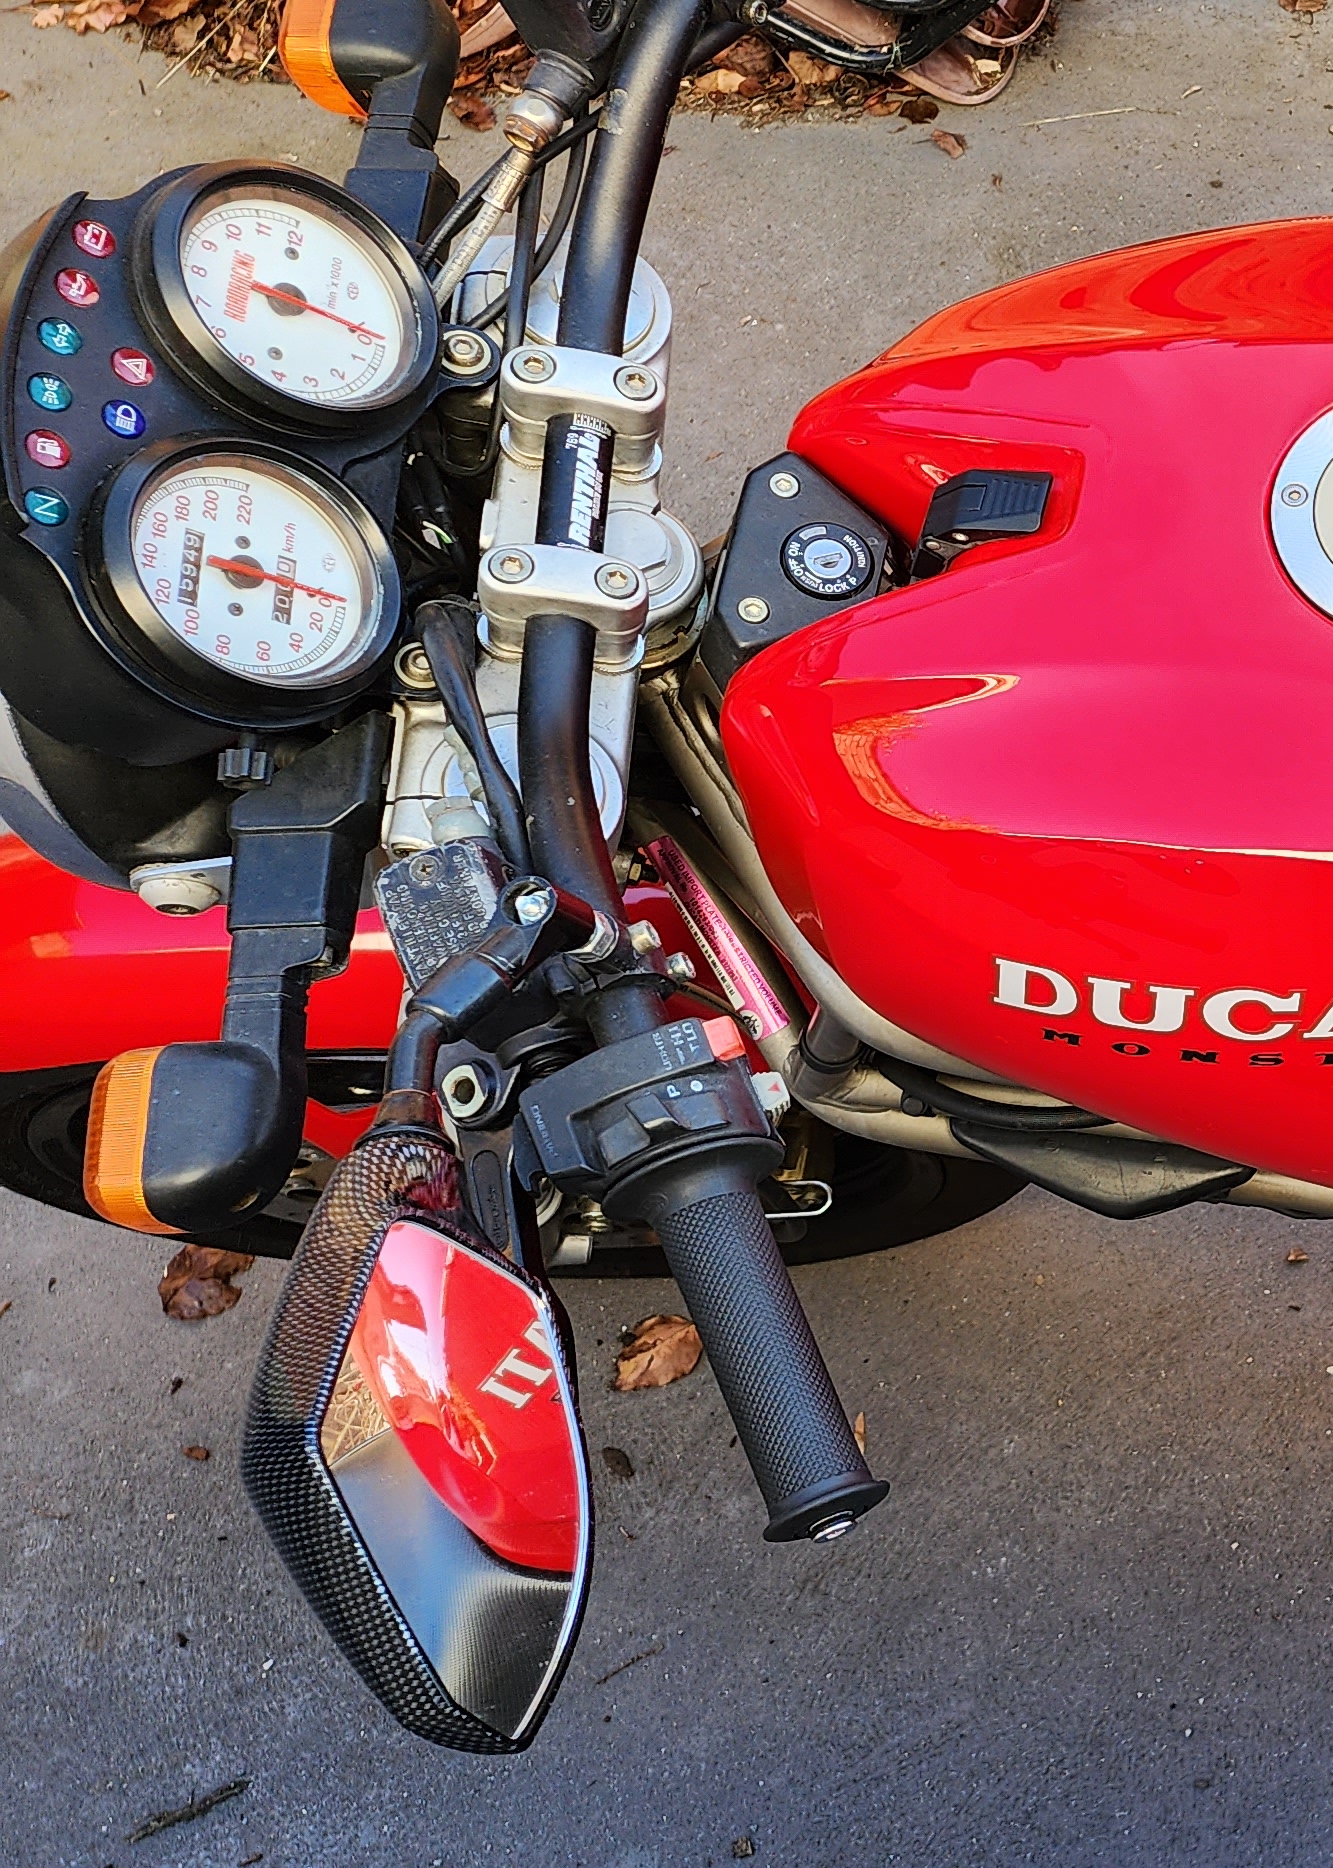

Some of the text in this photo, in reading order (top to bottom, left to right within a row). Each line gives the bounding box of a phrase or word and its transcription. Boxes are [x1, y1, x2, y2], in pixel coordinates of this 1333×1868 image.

[225, 223, 243, 241] 10
[254, 221, 273, 237] 11
[201, 239, 219, 253] 9
[286, 230, 304, 247] 12
[191, 264, 207, 278] 8
[195, 294, 212, 308] 7
[210, 325, 227, 340] 6
[239, 352, 256, 367] 5
[270, 369, 287, 383] 4
[303, 375, 320, 388] 3
[329, 367, 346, 381] 2
[568, 433, 601, 547] RENTHAL
[34, 492, 60, 519] N
[174, 495, 190, 522] 180
[202, 489, 220, 522] 200
[236, 495, 253, 526] 220
[151, 511, 169, 539] 160
[141, 542, 158, 569] 140
[788, 541, 801, 556] ON
[788, 558, 804, 576] OFF
[154, 578, 172, 605] 120
[819, 581, 850, 593] LOCK
[183, 608, 200, 637] 100
[309, 611, 324, 633] 20
[215, 633, 231, 656] 80
[256, 640, 271, 662] 60
[288, 632, 304, 653] 40
[666, 1084, 681, 1098] P
